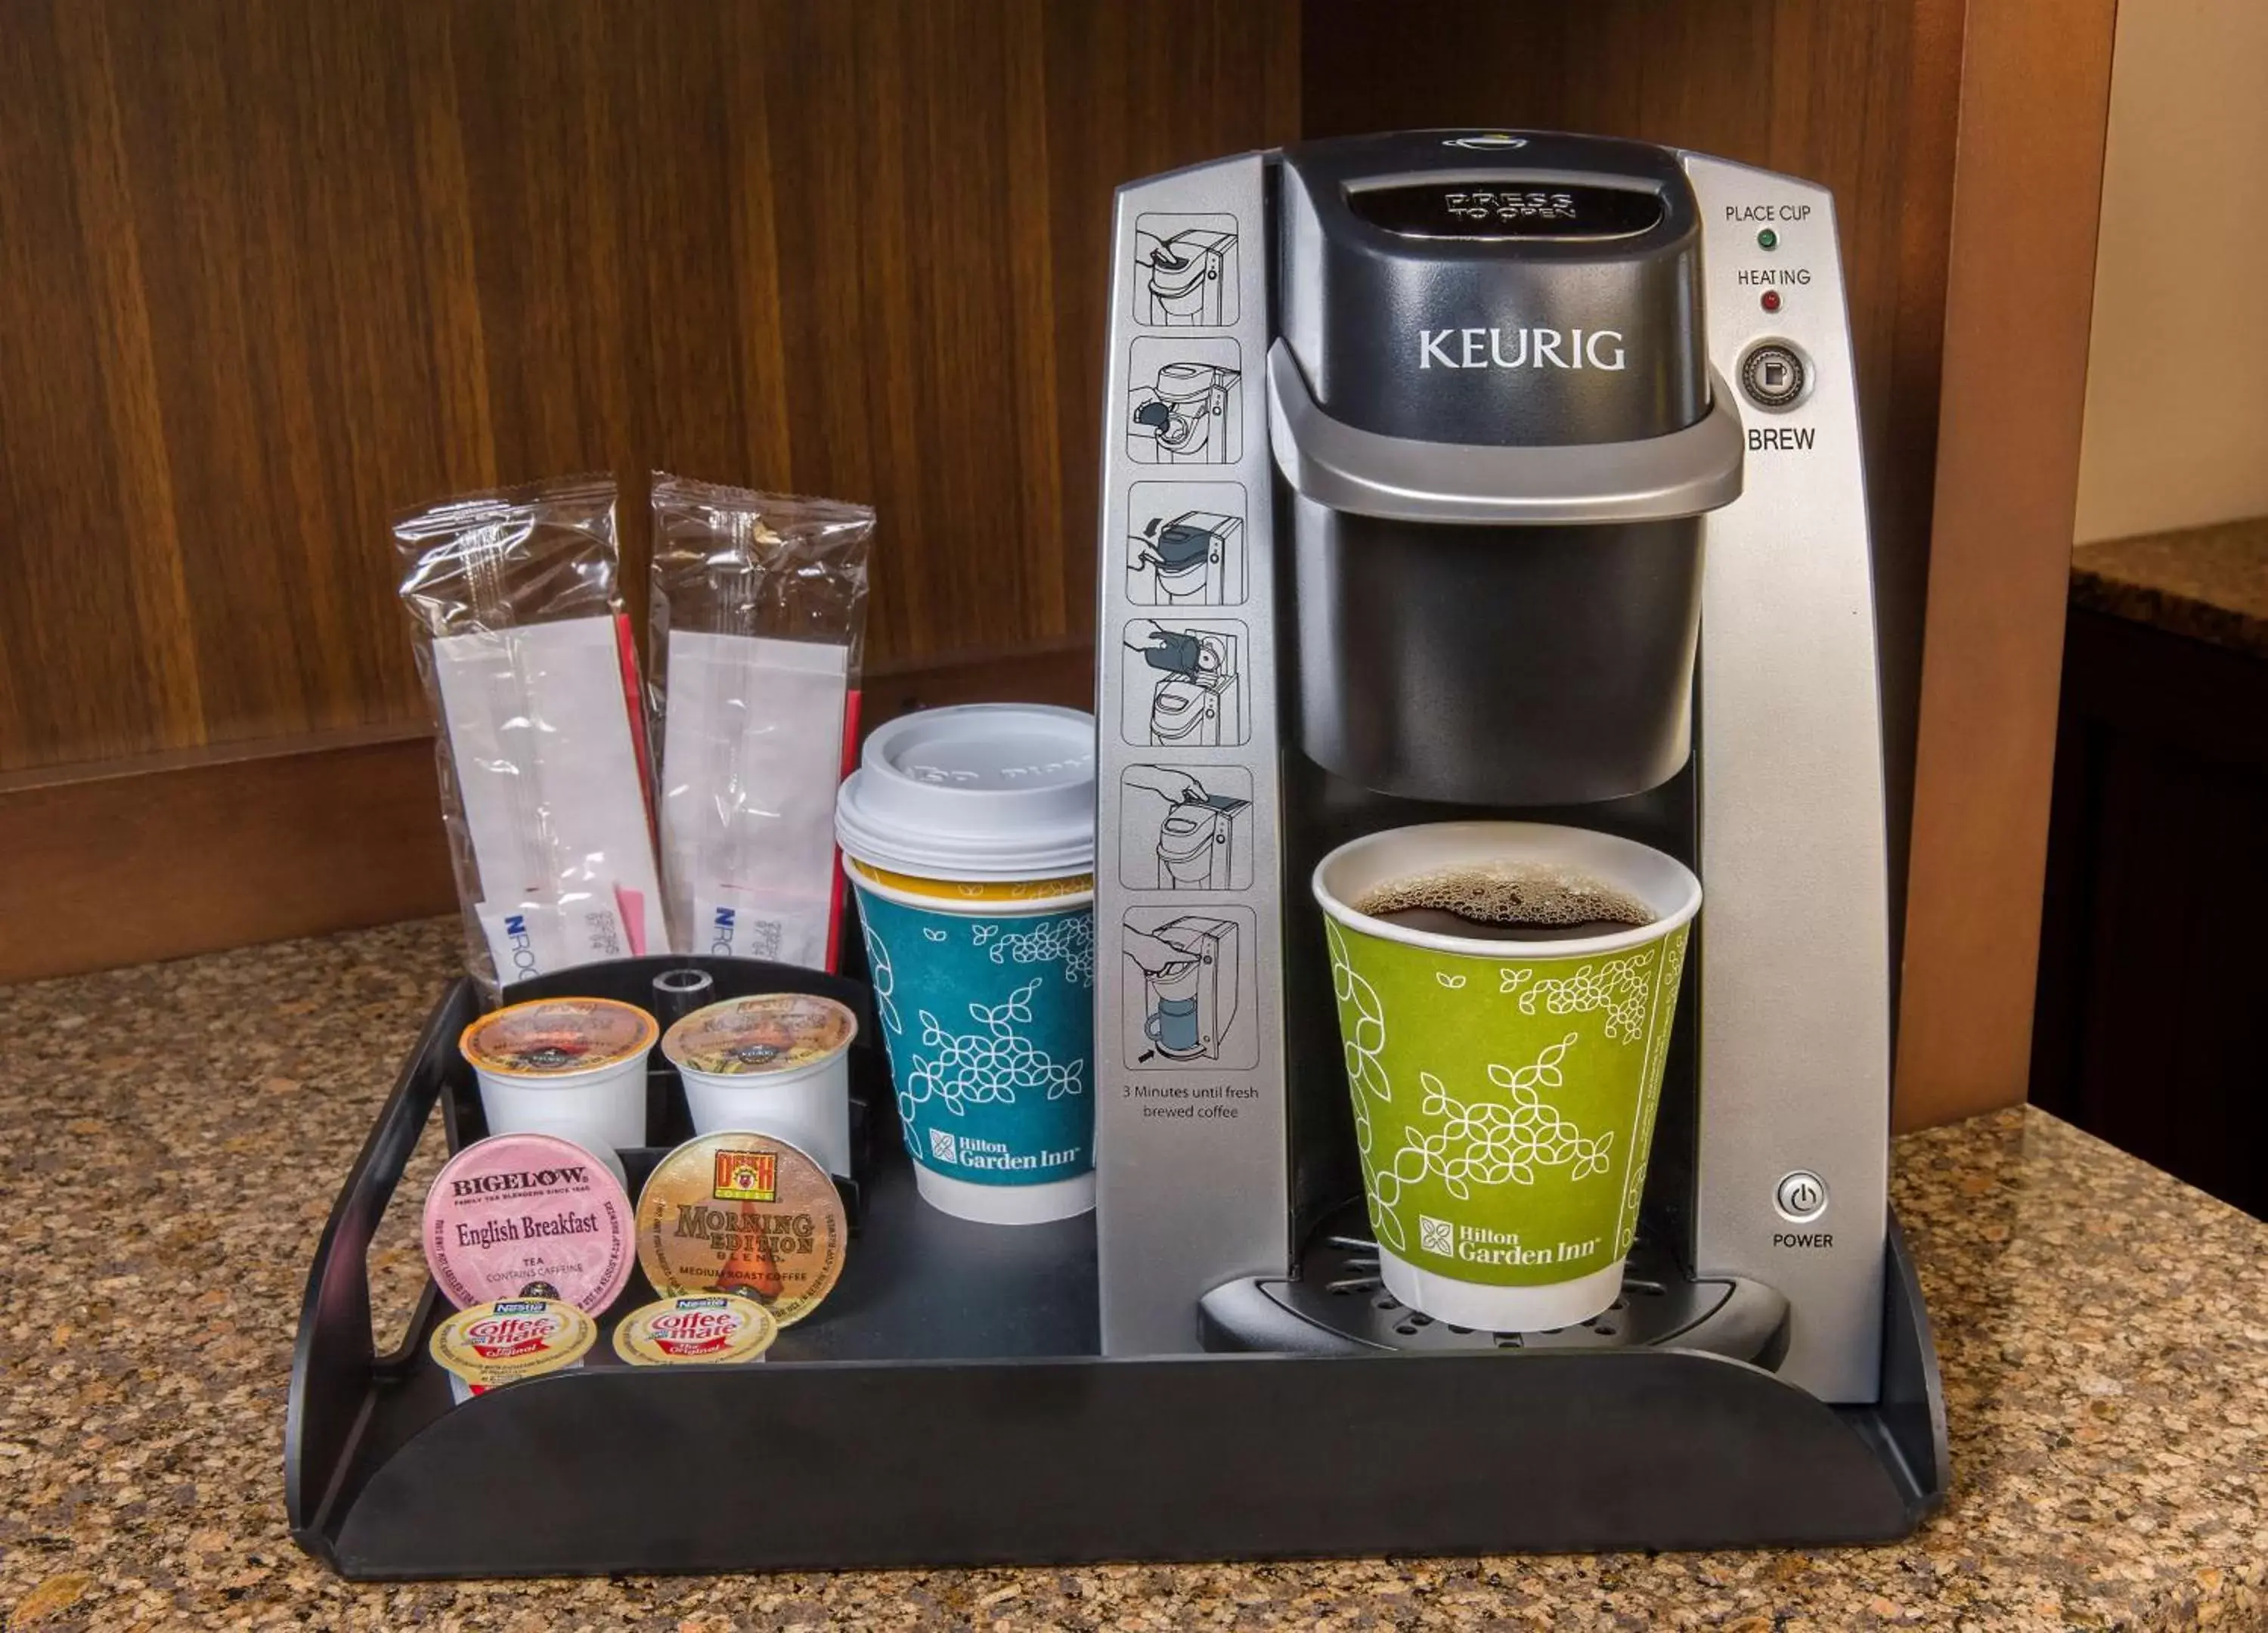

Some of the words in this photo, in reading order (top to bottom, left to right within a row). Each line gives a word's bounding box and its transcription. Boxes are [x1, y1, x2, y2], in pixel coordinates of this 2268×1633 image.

[1445, 193, 1573, 208] PRESS
[1448, 208, 1490, 218] TO
[1496, 208, 1576, 219] OPEN
[1725, 205, 1775, 222] PLACE
[1779, 205, 1811, 222] CUP
[1737, 268, 1811, 286] HEATING
[1418, 327, 1626, 370] KEURIG
[1748, 428, 1816, 451] BREW
[1123, 1086, 1131, 1098] 3
[1134, 1086, 1189, 1098] Minutes
[1192, 1086, 1222, 1098] until
[1225, 1086, 1259, 1098] fresh
[1143, 1105, 1194, 1118] brewed
[1197, 1104, 1239, 1118] coffee
[959, 1136, 1007, 1153] Hilton
[959, 1150, 1037, 1170] Garden
[1040, 1149, 1075, 1167] Inn
[455, 1218, 519, 1250] English
[521, 1212, 600, 1239] Breakfast
[674, 1204, 816, 1241] MORNING
[711, 1233, 813, 1255] EDITION
[1460, 1226, 1519, 1244] Hilton
[1773, 1234, 1833, 1248] POWER
[1458, 1241, 1552, 1265] Garden
[1557, 1240, 1594, 1262] Inn
[523, 1258, 544, 1267] TEA
[486, 1269, 536, 1282] CONTAINS
[538, 1263, 584, 1276] CAFFEINE
[680, 1266, 723, 1279] MEDIUM
[727, 1271, 762, 1280] ROAST
[766, 1273, 807, 1281] COFFEE
[469, 1318, 550, 1337] Coffee
[652, 1312, 731, 1330] Coffee
[488, 1325, 555, 1343] mate
[671, 1324, 737, 1339] mate
